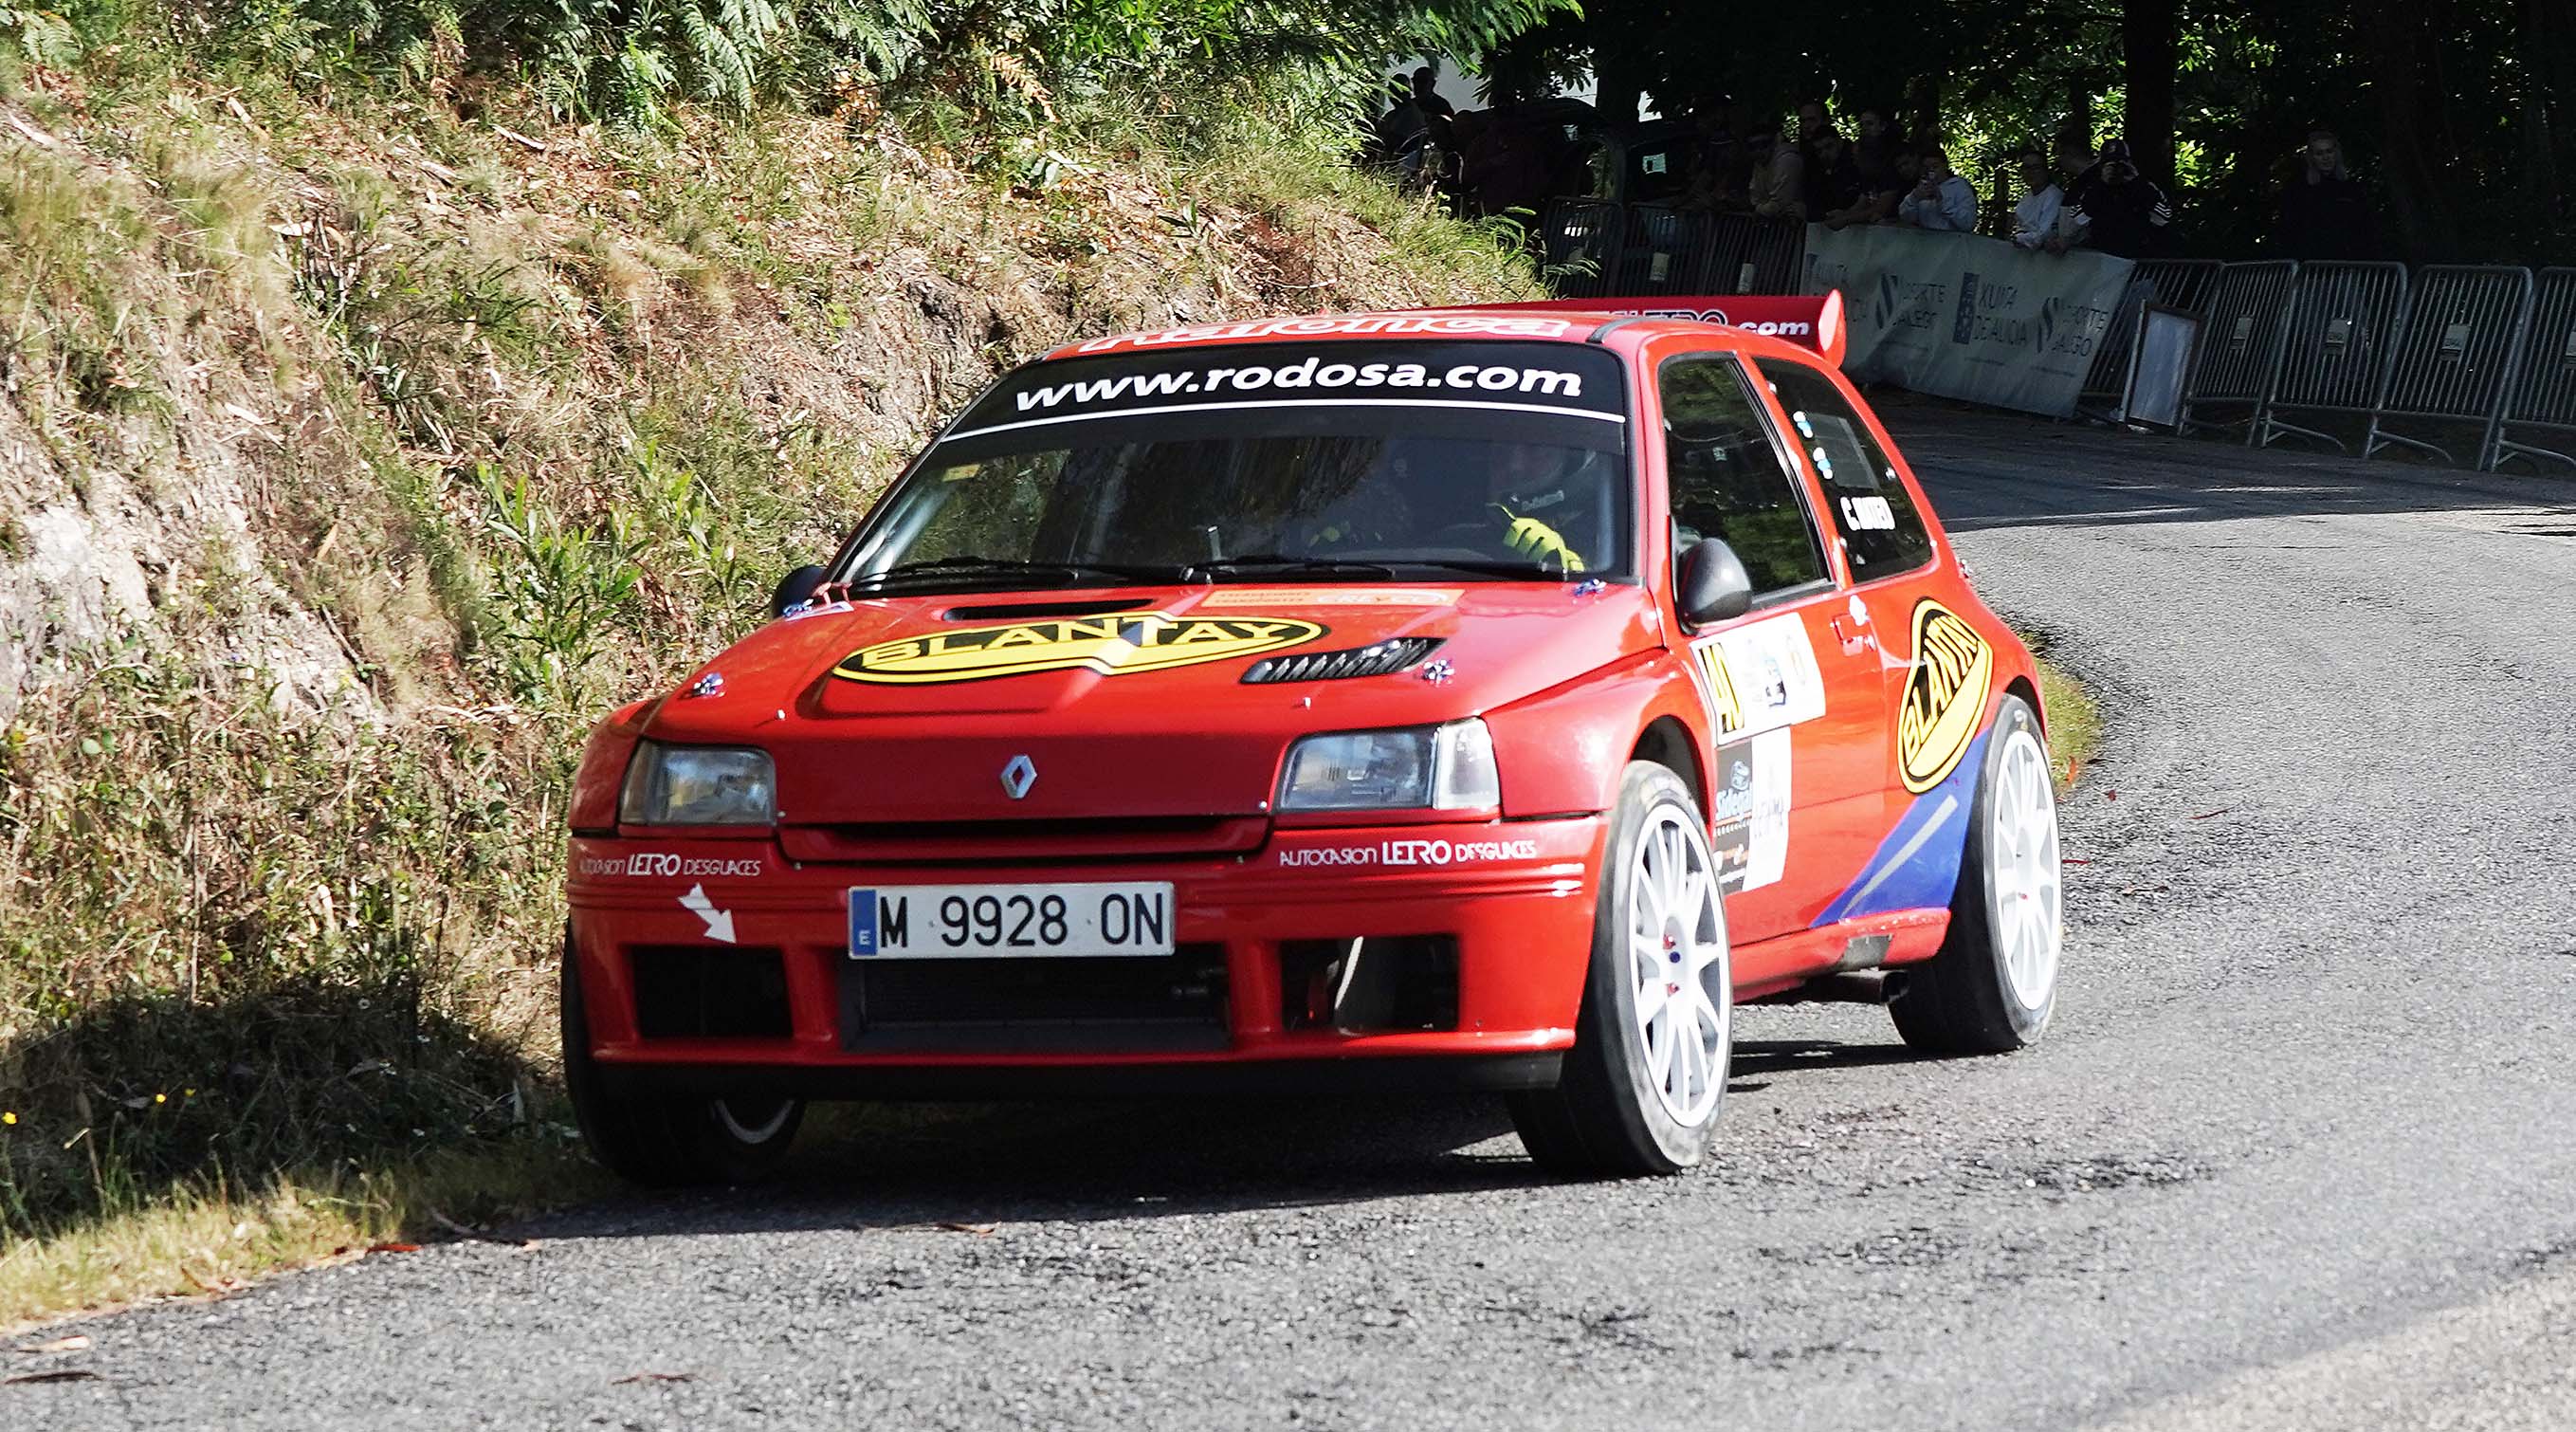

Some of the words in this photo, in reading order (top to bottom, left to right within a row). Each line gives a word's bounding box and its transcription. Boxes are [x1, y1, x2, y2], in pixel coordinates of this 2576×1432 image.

[1016, 357, 1582, 412] www.rodosa.com
[861, 616, 1293, 667] BLANTAY
[1902, 615, 1981, 763] BLANTAY
[627, 854, 682, 876] LETRO
[683, 859, 762, 876] DESGUACES
[1382, 840, 1452, 865] LETRO
[1455, 840, 1537, 862] DESGUACES
[859, 931, 870, 945] E
[880, 898, 908, 947] M
[941, 896, 1069, 946] 9928
[1101, 893, 1164, 945] ON
